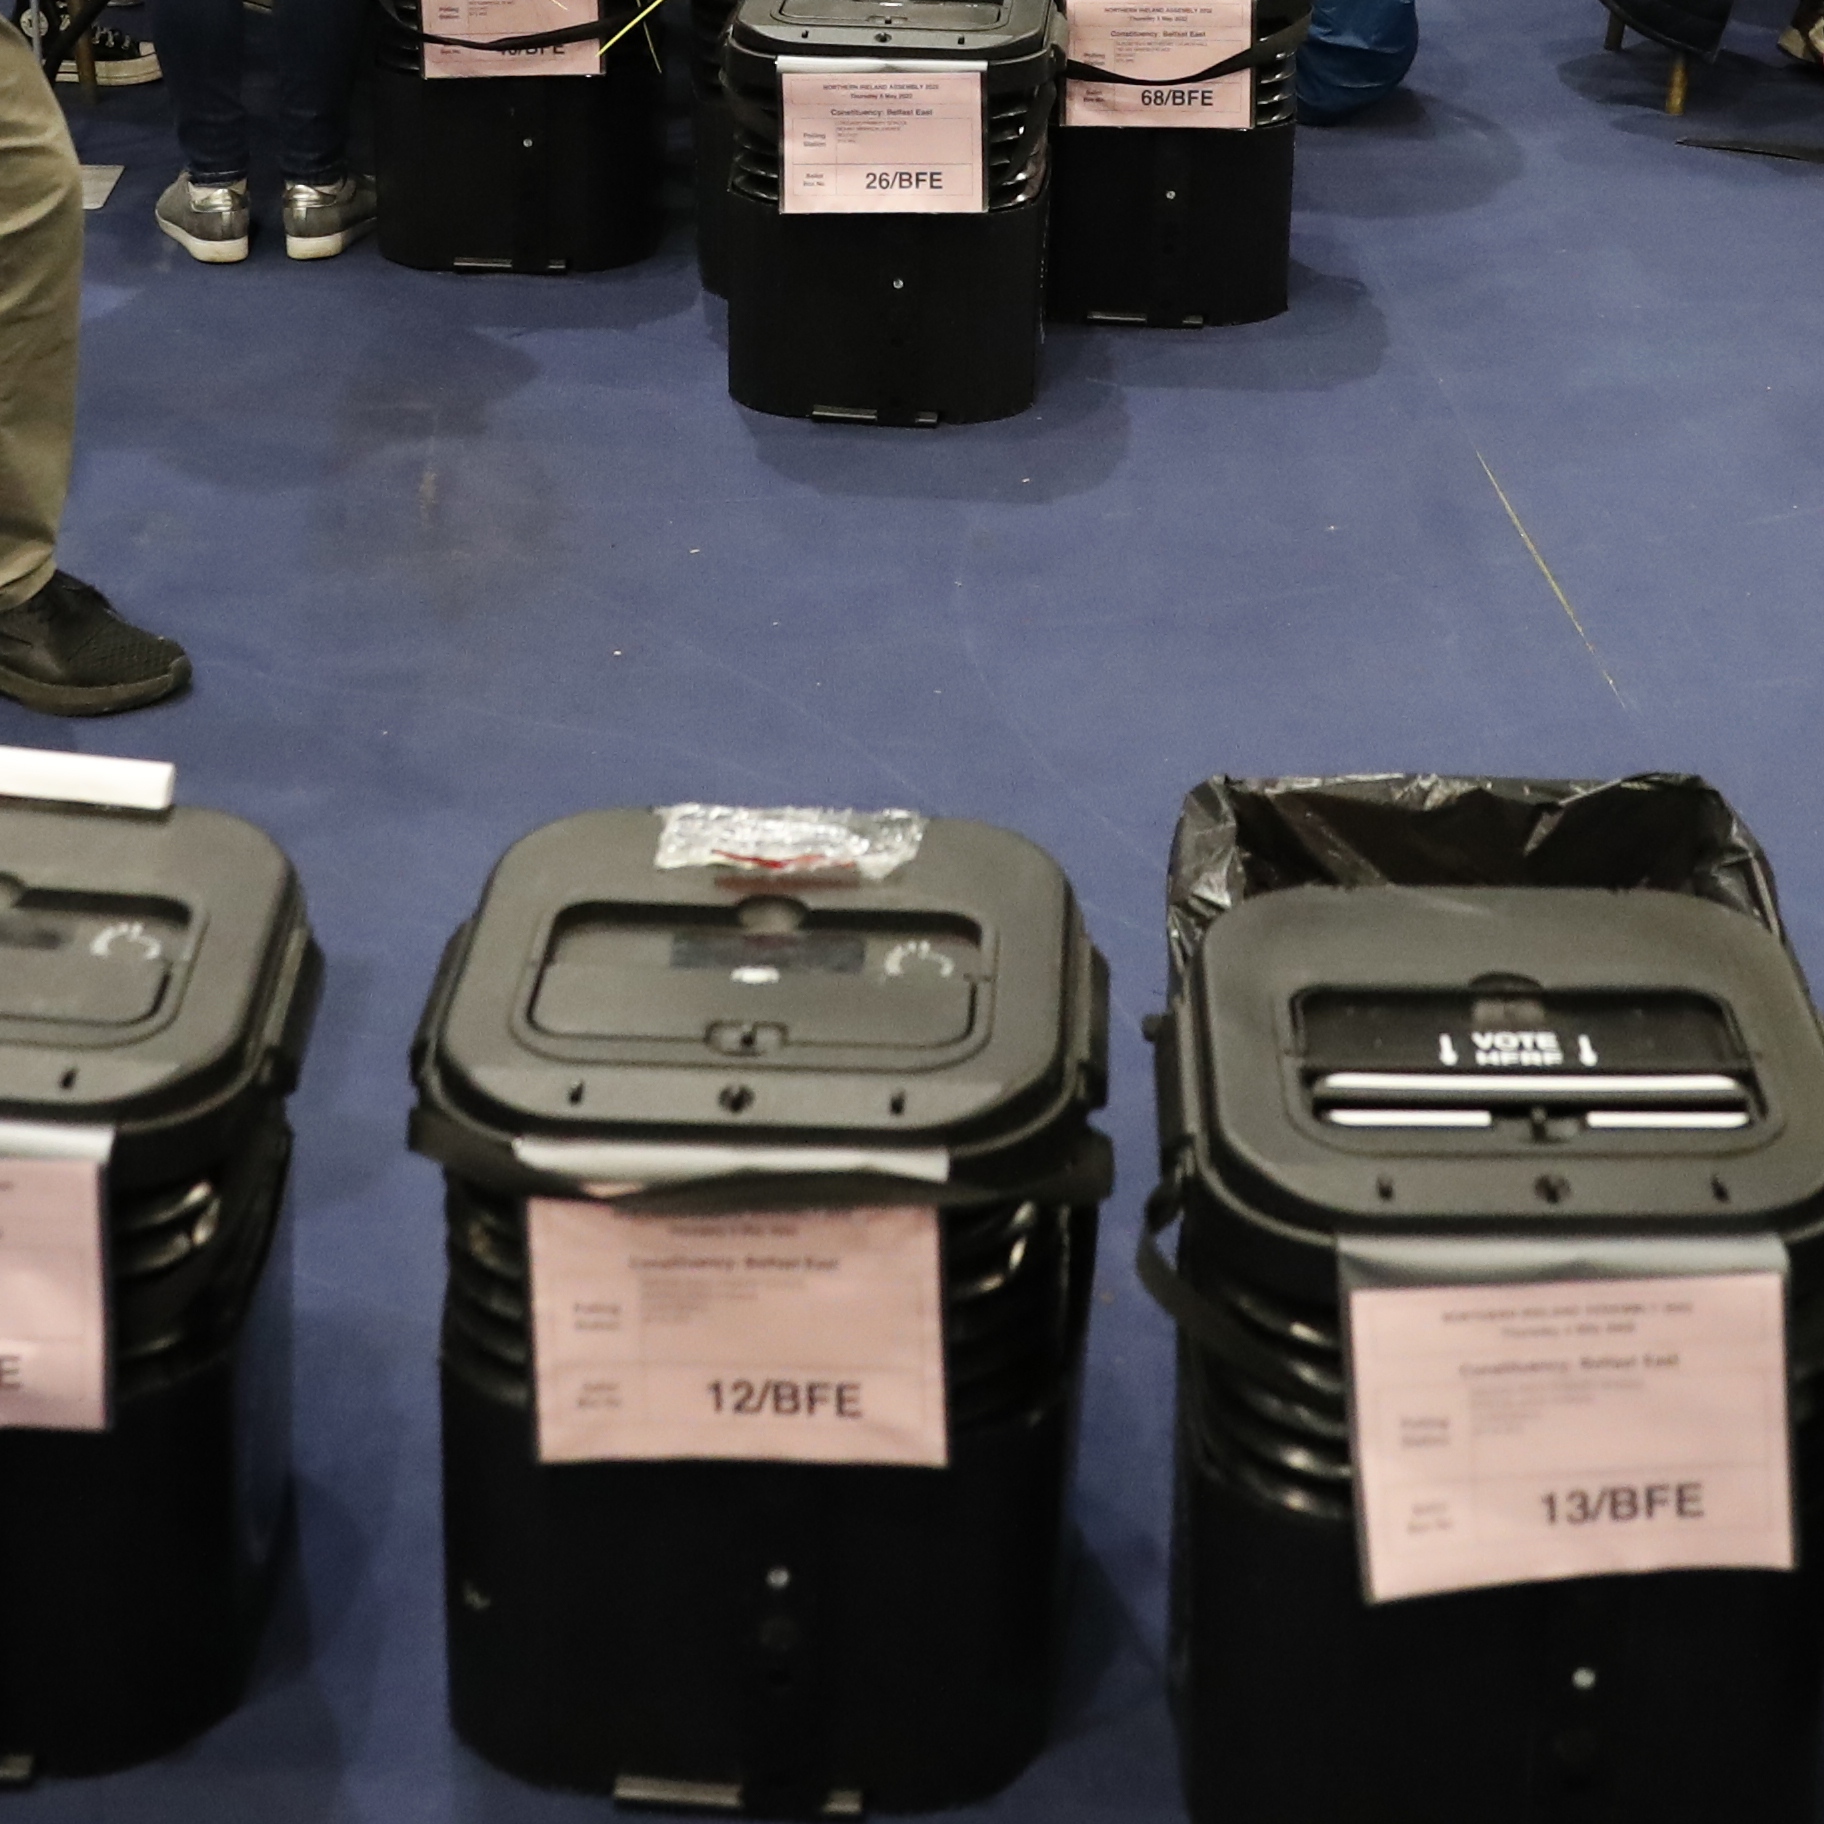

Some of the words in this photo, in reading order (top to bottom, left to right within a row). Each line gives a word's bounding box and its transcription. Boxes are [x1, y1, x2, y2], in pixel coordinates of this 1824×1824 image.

[1189, 30, 1206, 38] East
[1141, 89, 1214, 106] 68/BFE
[886, 108, 914, 116] Belfast
[916, 108, 933, 116] East
[865, 171, 944, 189] 26/BFE
[1472, 1031, 1558, 1051] VOTE
[1475, 1051, 1564, 1067] HERE
[708, 1378, 863, 1419] 12/BFE
[1541, 1481, 1705, 1526] 13/BFE
